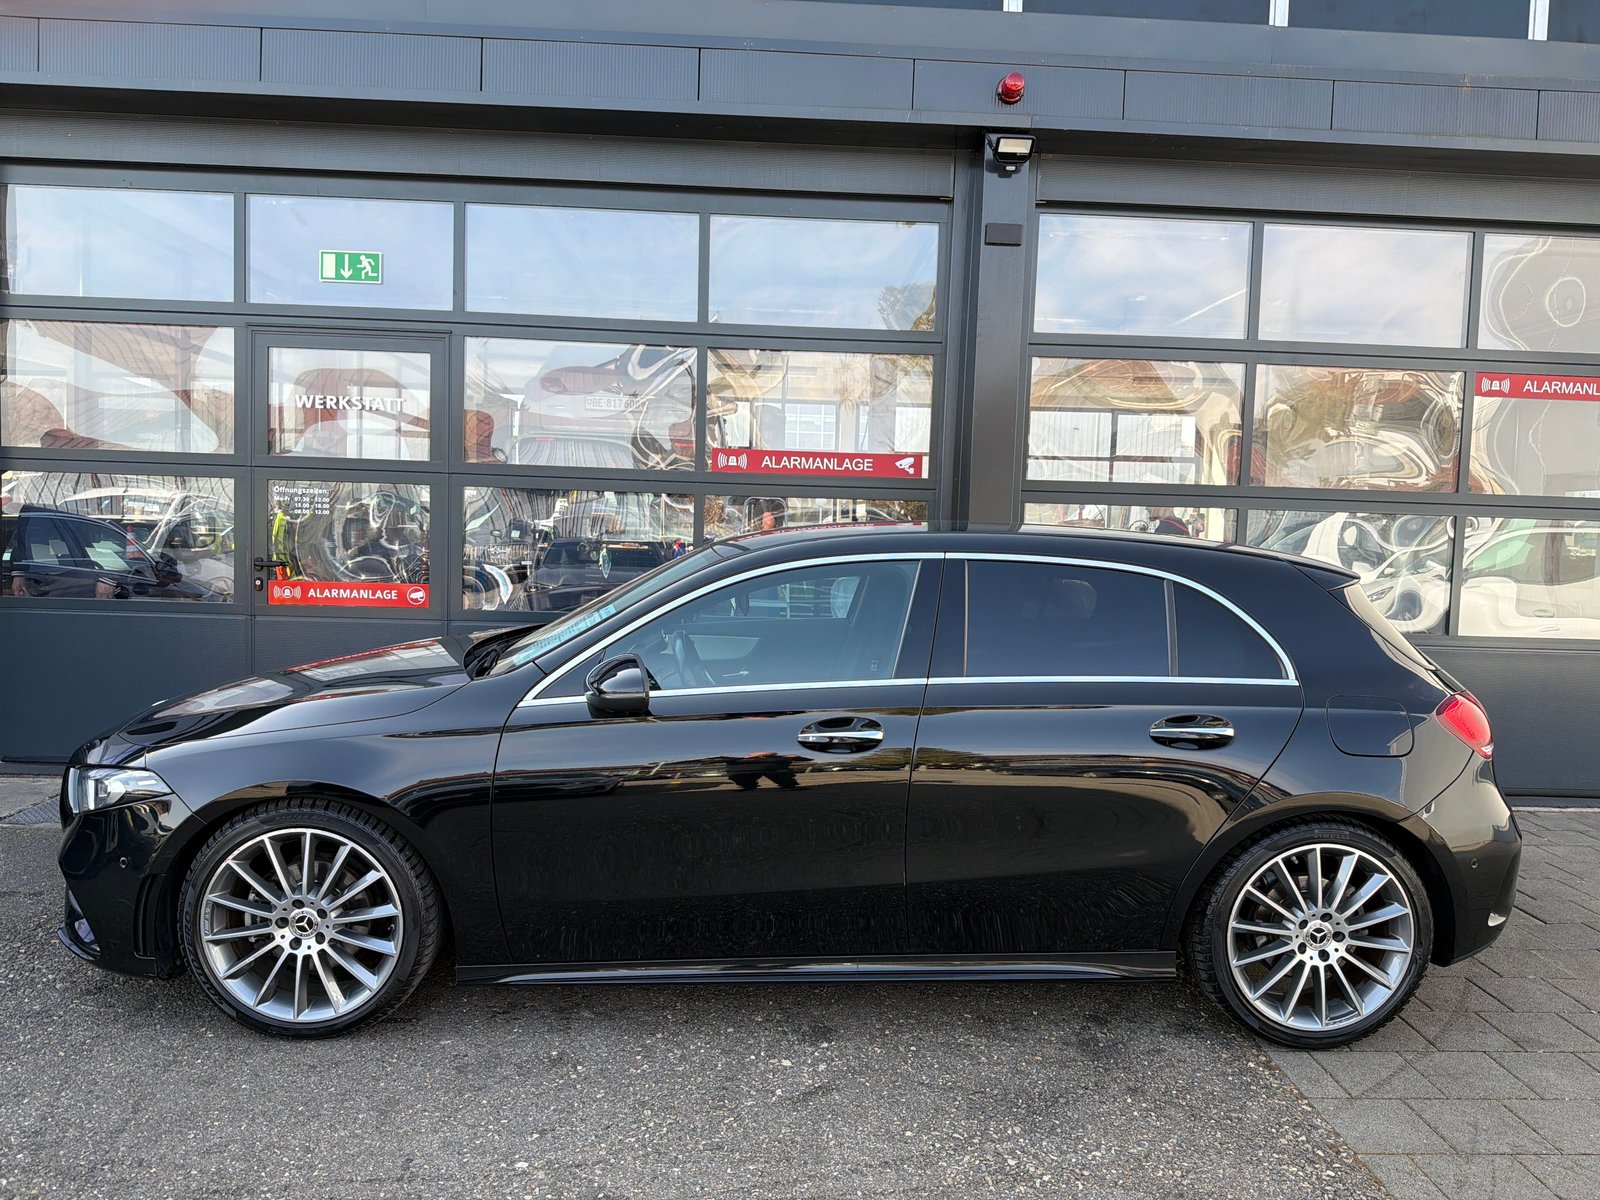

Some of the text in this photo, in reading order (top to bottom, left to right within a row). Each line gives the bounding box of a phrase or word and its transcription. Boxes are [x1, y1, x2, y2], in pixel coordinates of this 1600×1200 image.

[295, 394, 405, 412] WERKSTATT
[761, 455, 874, 472] ALARMANLAGE
[307, 587, 399, 601] ALARMANLAGE
